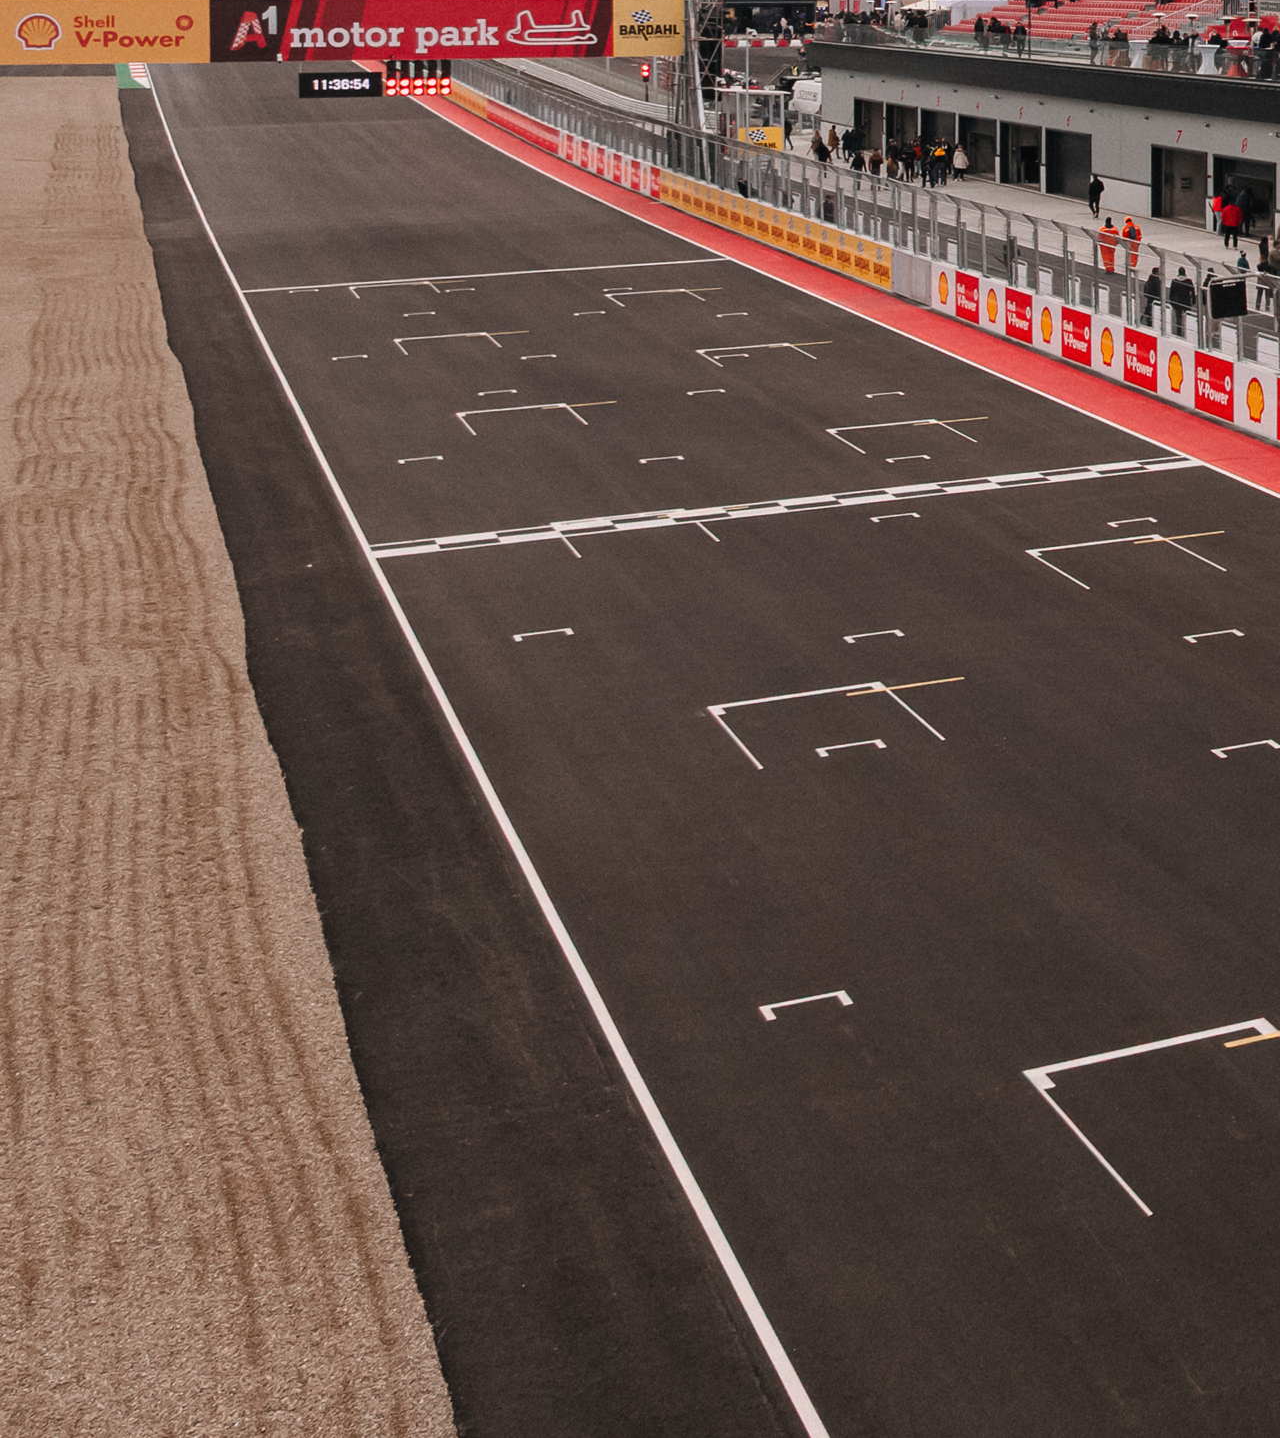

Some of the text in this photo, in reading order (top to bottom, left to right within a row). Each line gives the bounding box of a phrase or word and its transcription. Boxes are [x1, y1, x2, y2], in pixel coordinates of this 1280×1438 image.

[73, 15, 116, 29] Shell
[229, 5, 500, 54] A1 motor park
[75, 30, 185, 49] V-Power
[619, 24, 681, 40] BARDAHL
[312, 78, 371, 91] 11:36:54
[1240, 137, 1248, 154] 8
[1125, 340, 1137, 355] Shell
[1126, 353, 1154, 377] V-Power
[1197, 366, 1210, 383] Shell
[1197, 380, 1230, 406] V-Power
